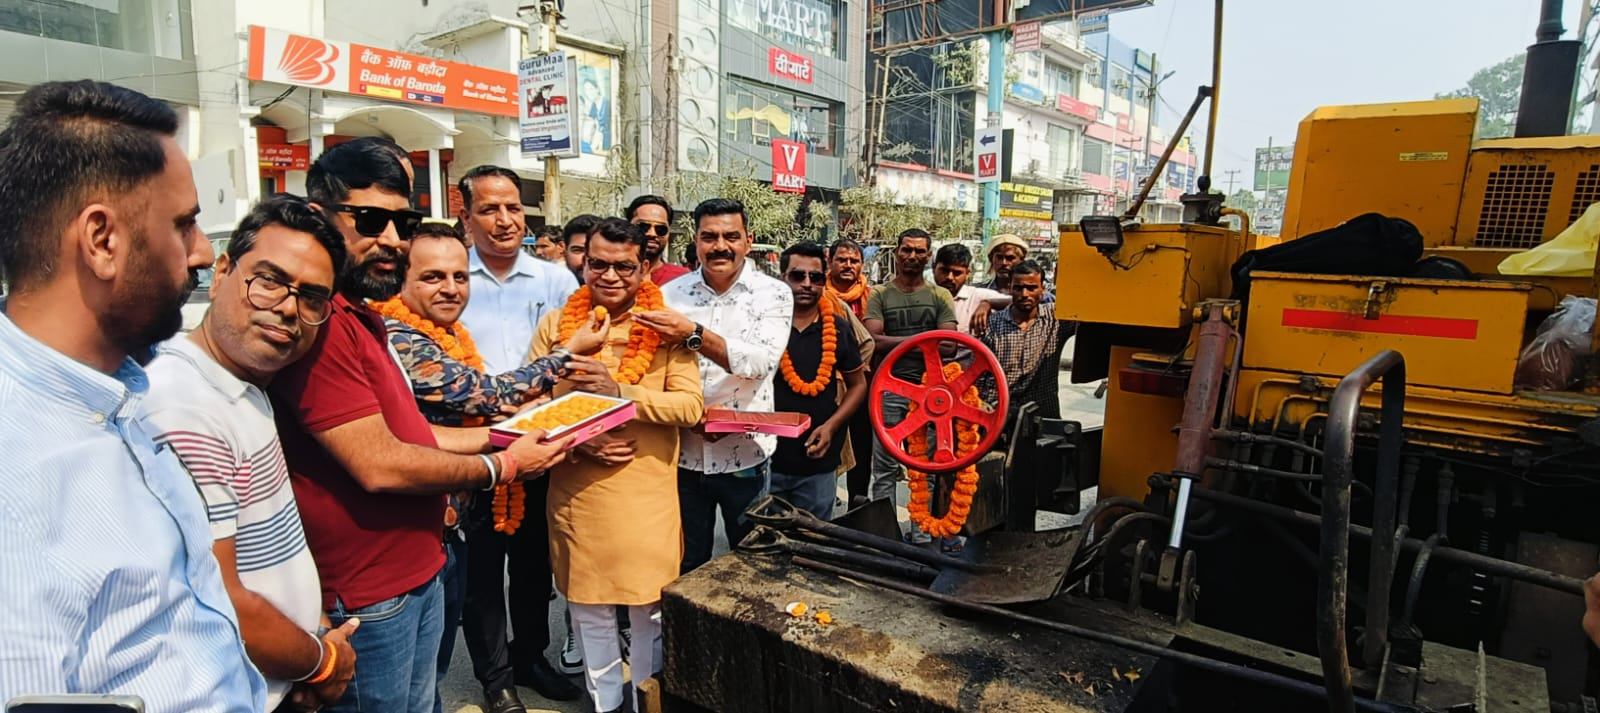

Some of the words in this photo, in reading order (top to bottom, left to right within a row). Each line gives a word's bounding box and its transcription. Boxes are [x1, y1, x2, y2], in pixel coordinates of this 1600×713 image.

[755, 0, 828, 43] MART
[360, 48, 382, 65] बैंक
[417, 61, 448, 77] बड़ौदा
[519, 59, 541, 71] Guru
[543, 55, 563, 66] Maa
[519, 76, 542, 85] DENTAL
[543, 71, 565, 81] CLINIC
[528, 66, 555, 76] Advanced
[360, 68, 391, 85] Bank
[393, 76, 406, 87] of
[406, 77, 447, 94] Baroda
[462, 89, 478, 97] Bank
[486, 94, 508, 103] Baroda
[781, 144, 800, 171] V
[981, 154, 993, 169] V
[980, 167, 996, 175] MART
[775, 172, 806, 189] MART
[884, 308, 938, 329] FILA
